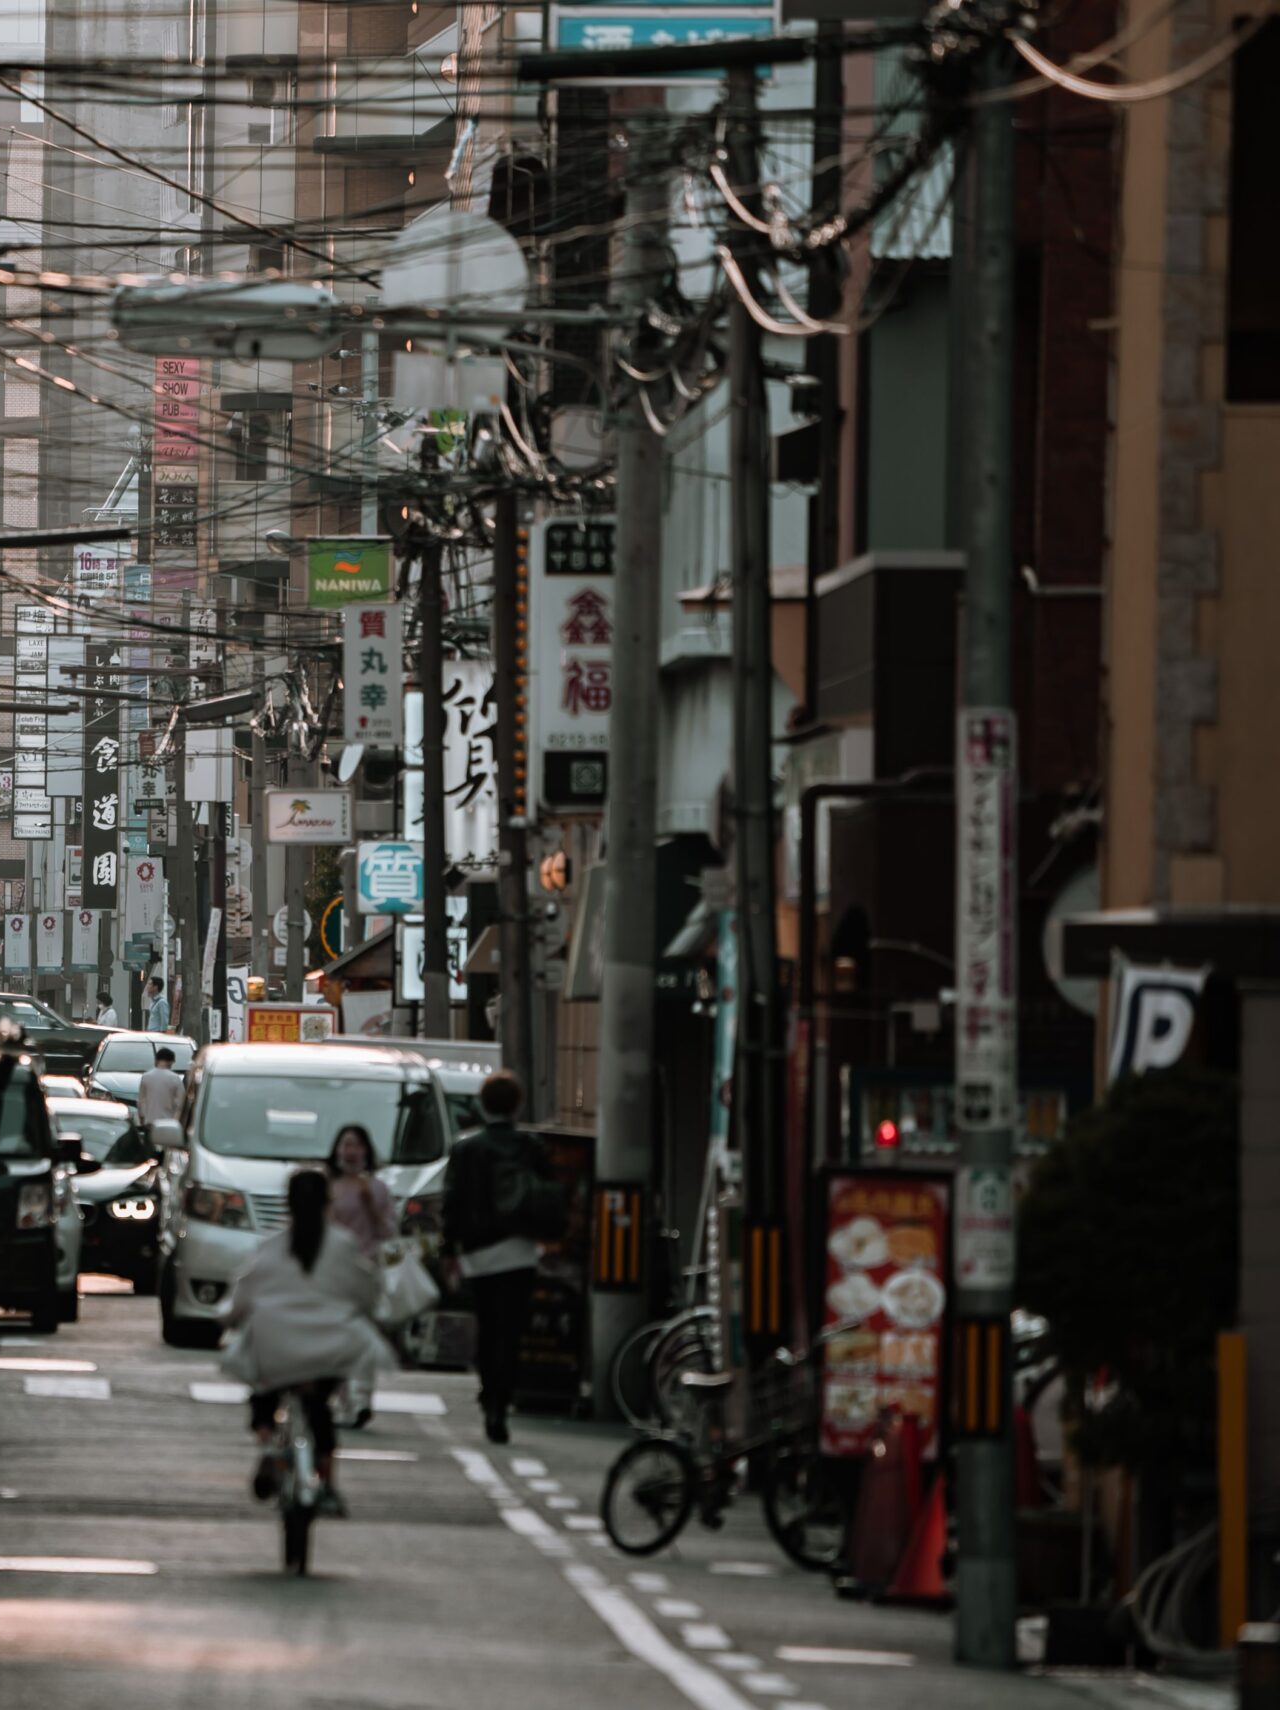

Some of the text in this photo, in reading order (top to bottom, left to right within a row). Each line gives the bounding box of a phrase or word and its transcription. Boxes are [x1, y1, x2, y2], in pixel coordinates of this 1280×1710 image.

[162, 361, 185, 374] SEXY
[162, 382, 189, 396] SHOW
[162, 403, 180, 416] PUB
[315, 578, 383, 593] NANIWA
[90, 735, 120, 888] 食道園
[365, 850, 424, 906] 質
